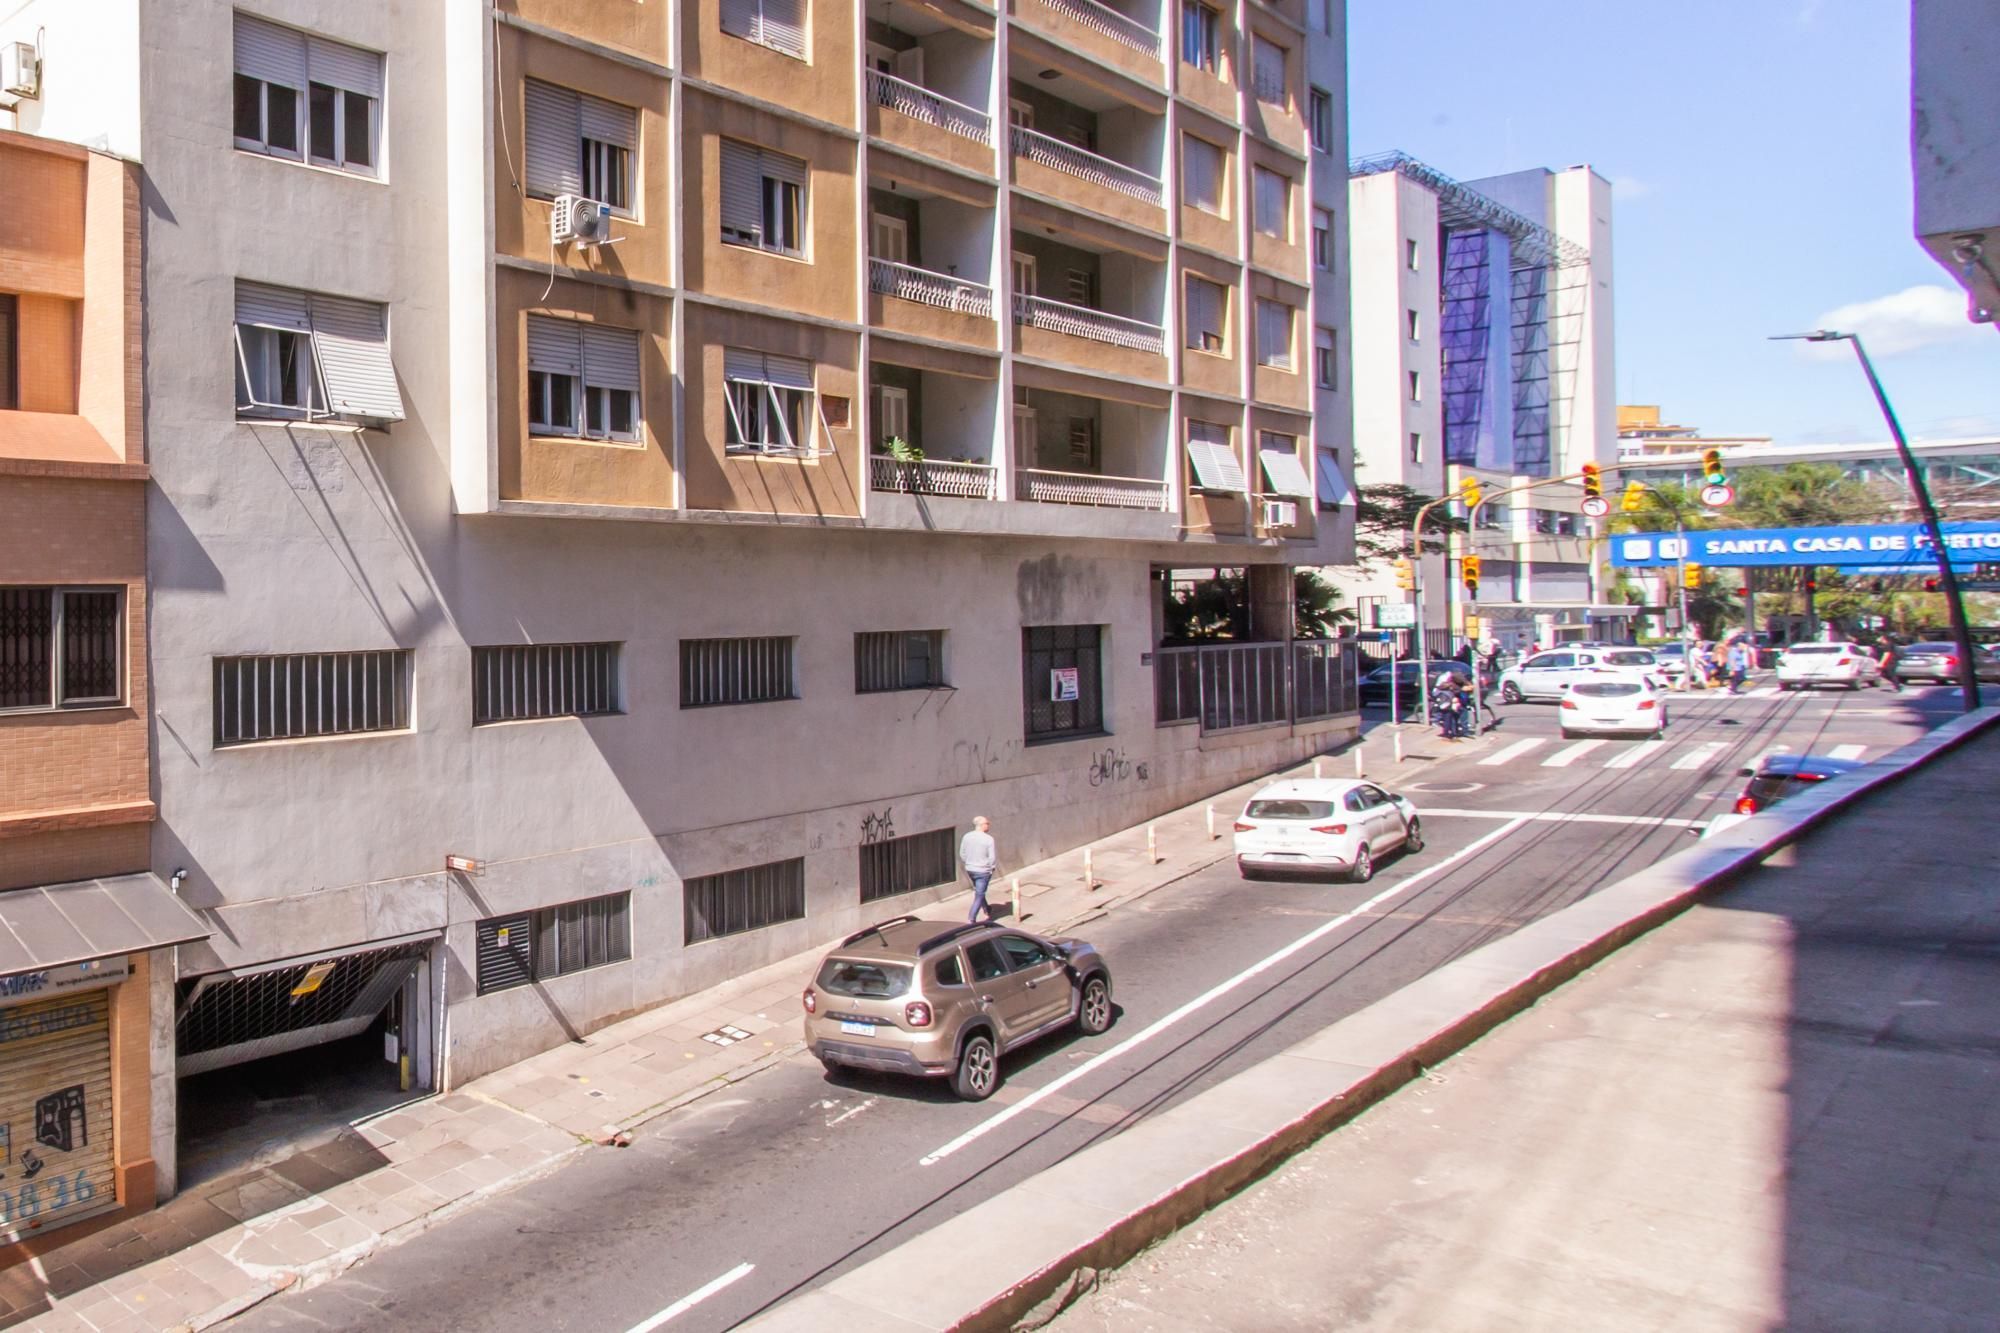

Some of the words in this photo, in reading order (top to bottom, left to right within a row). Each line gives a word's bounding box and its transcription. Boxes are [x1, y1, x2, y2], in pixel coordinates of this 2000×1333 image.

[1706, 539, 1787, 555] SANTA
[1792, 537, 1862, 553] CASA
[1869, 535, 1905, 551] DE
[1913, 532, 2000, 549] PRTO
